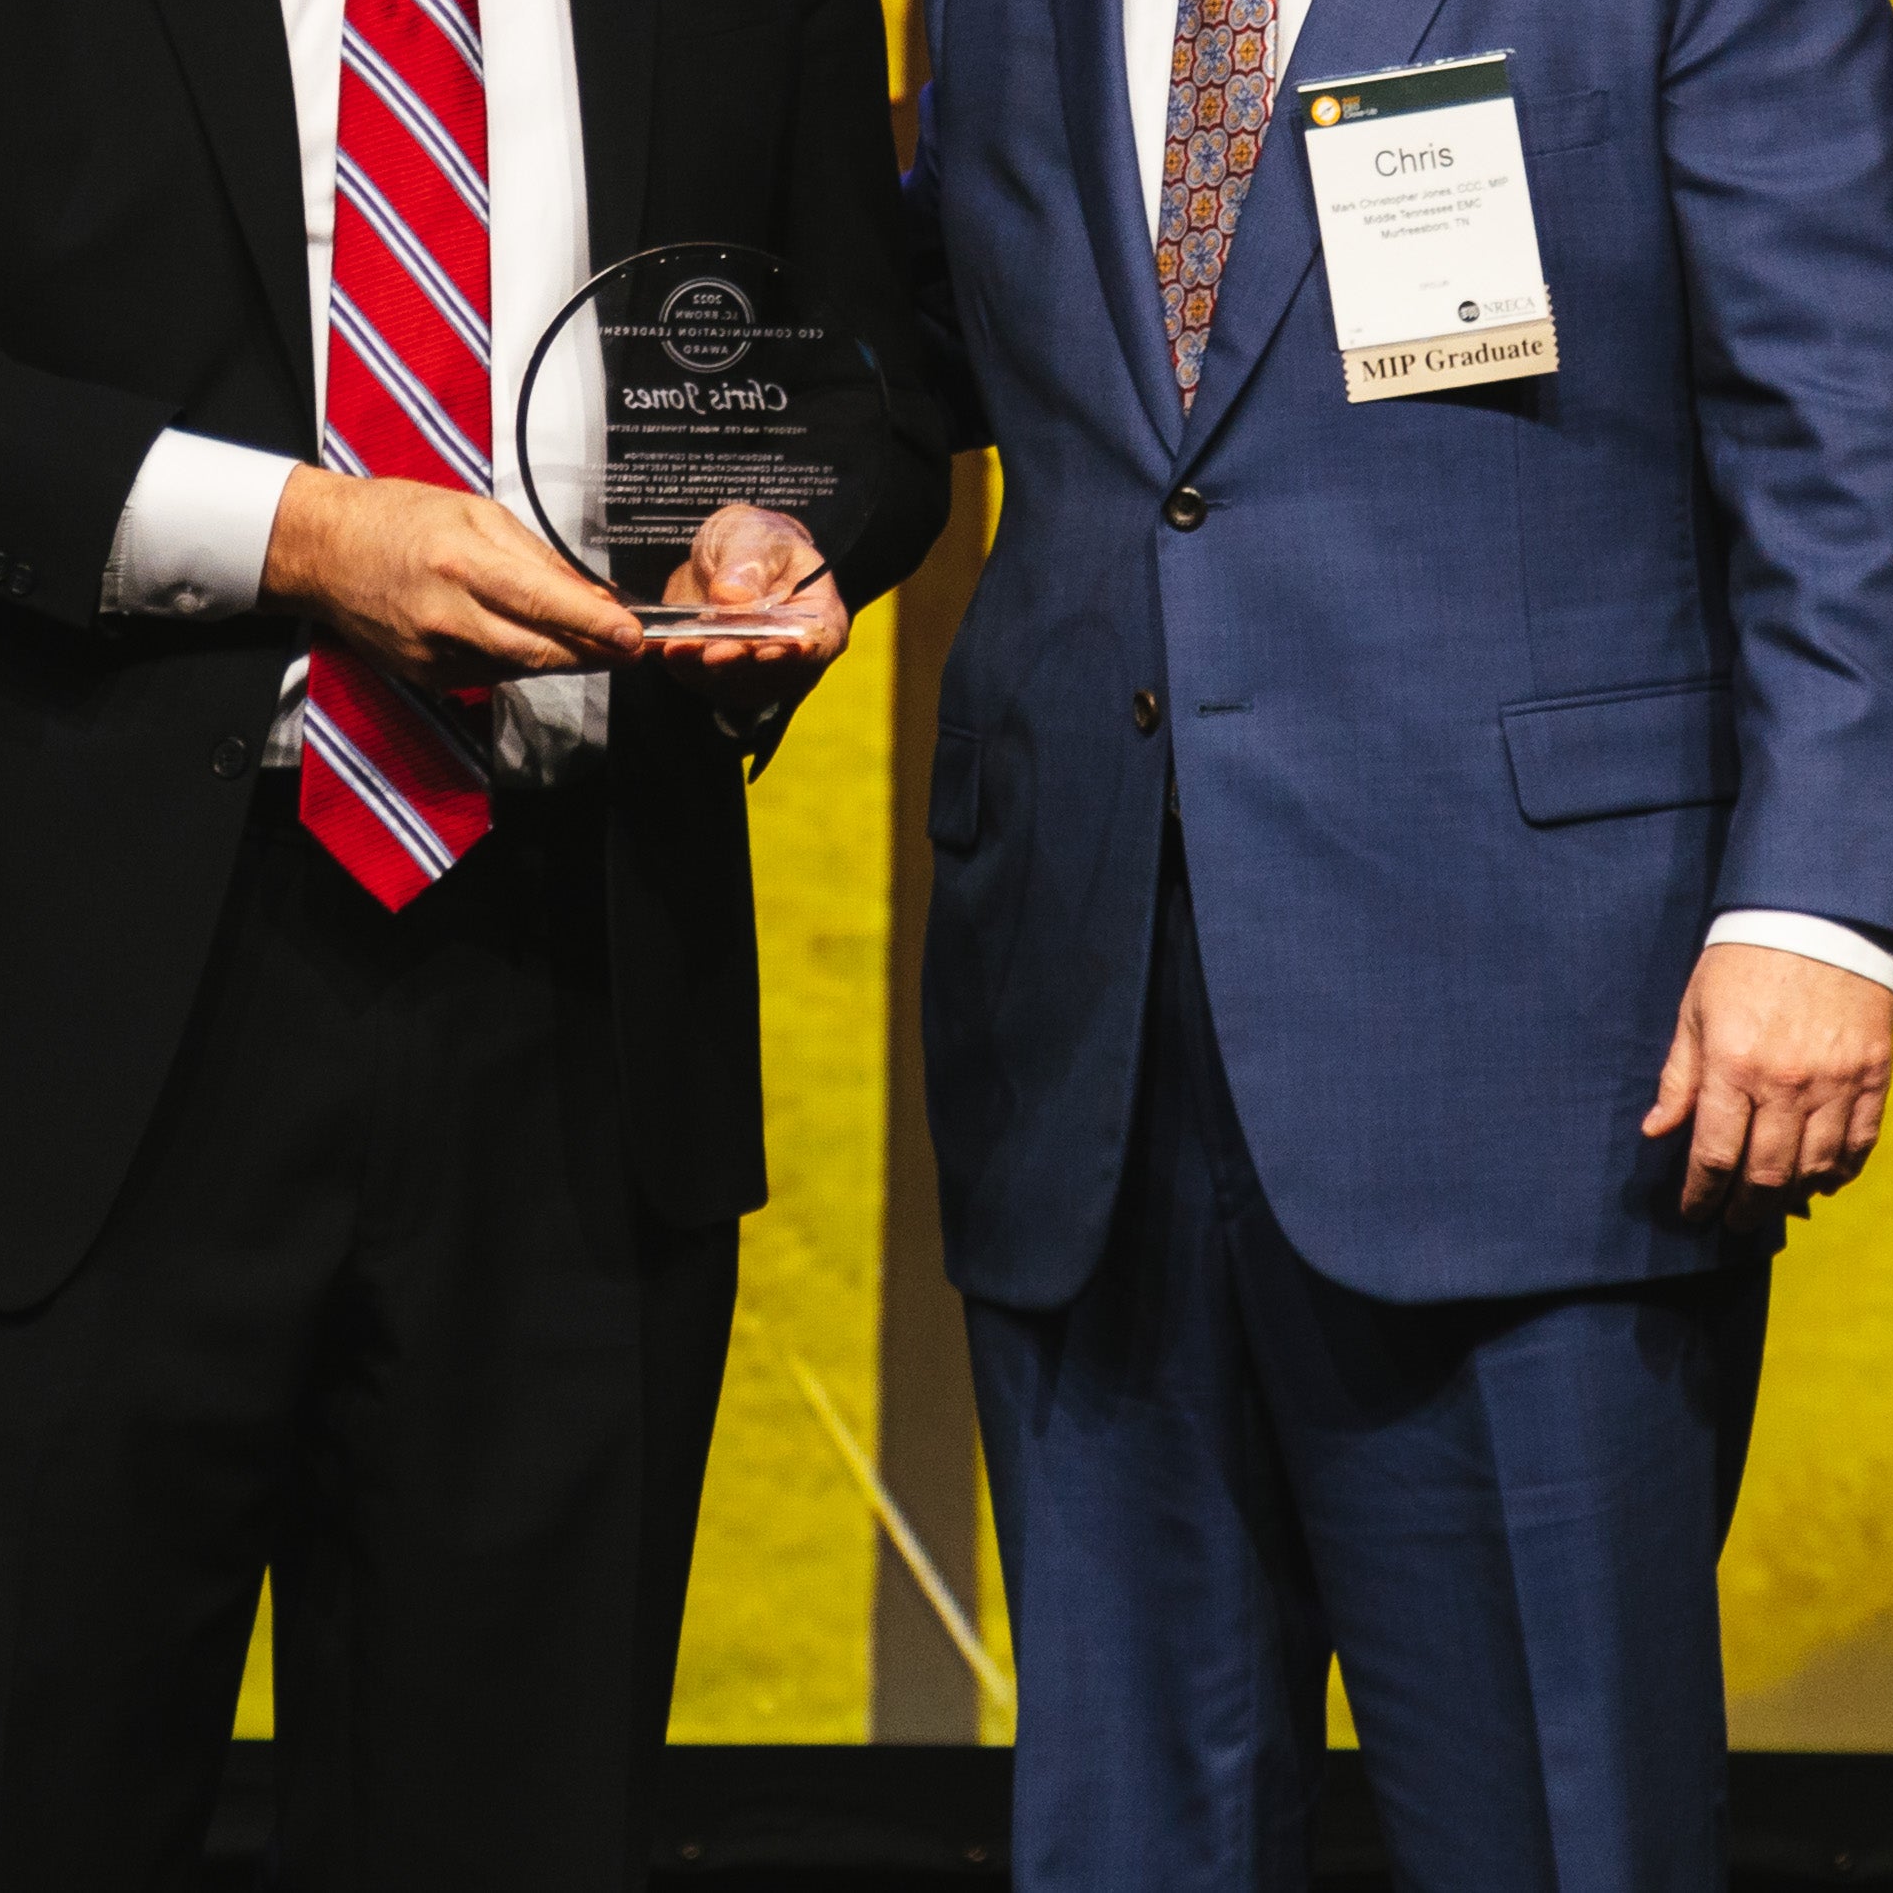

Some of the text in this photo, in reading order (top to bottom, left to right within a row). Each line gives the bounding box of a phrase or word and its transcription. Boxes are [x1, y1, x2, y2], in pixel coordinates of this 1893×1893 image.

[1374, 142, 1454, 177] Chris
[1361, 339, 1544, 383] MIP Graduate
